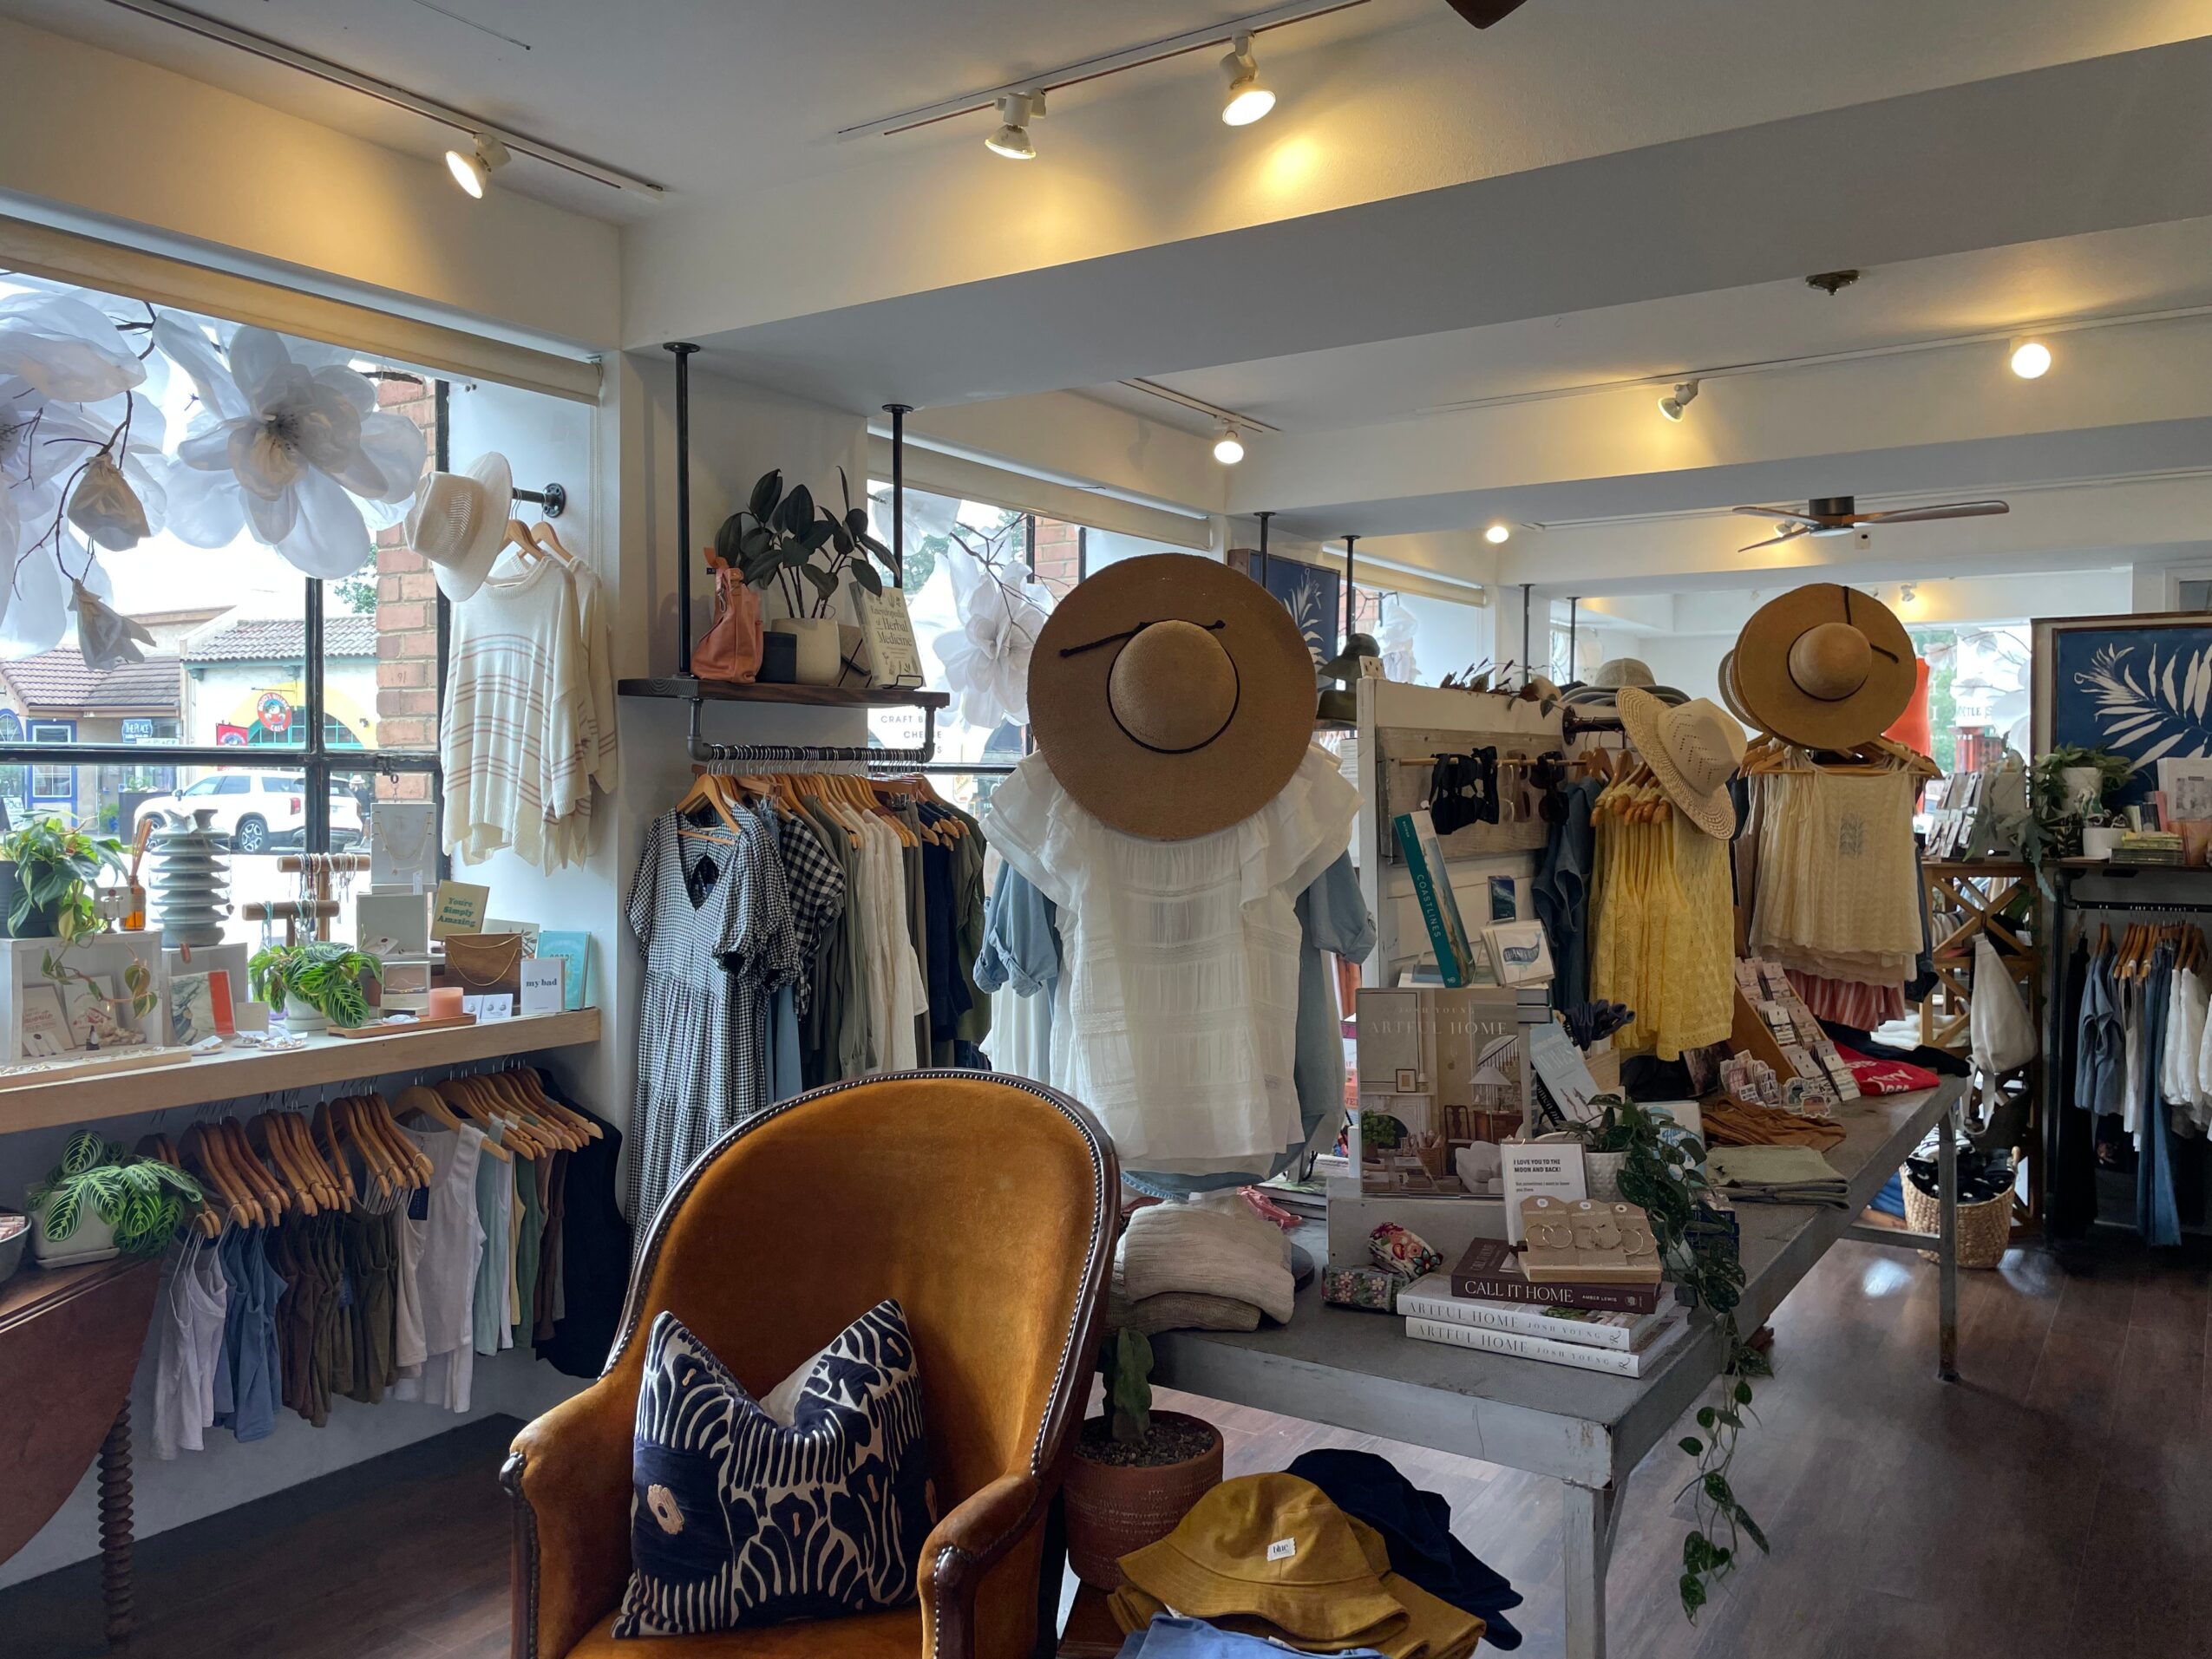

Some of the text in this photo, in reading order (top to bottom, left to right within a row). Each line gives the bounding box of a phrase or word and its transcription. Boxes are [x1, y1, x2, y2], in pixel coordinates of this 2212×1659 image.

[881, 616, 909, 632] Herbal
[877, 630, 913, 647] Medicine
[443, 906, 474, 918] Simply
[1417, 873, 1442, 937] COASTLINES
[526, 978, 558, 989] my bad
[1369, 1021, 1508, 1035] ARTFUL HOME
[1464, 1280, 1503, 1297] CALL
[1507, 1284, 1522, 1298] IT
[1526, 1285, 1574, 1303] HOME
[1408, 1301, 1466, 1321] ARTFUL
[1472, 1310, 1519, 1329] HOME
[1528, 1321, 1555, 1333] JOSH
[1561, 1326, 1602, 1340] YOUNG
[1417, 1323, 1472, 1343] ARTFUL
[1480, 1334, 1528, 1355] HOME
[1536, 1347, 1565, 1358] JOSH
[1571, 1352, 1610, 1366] YOUNG
